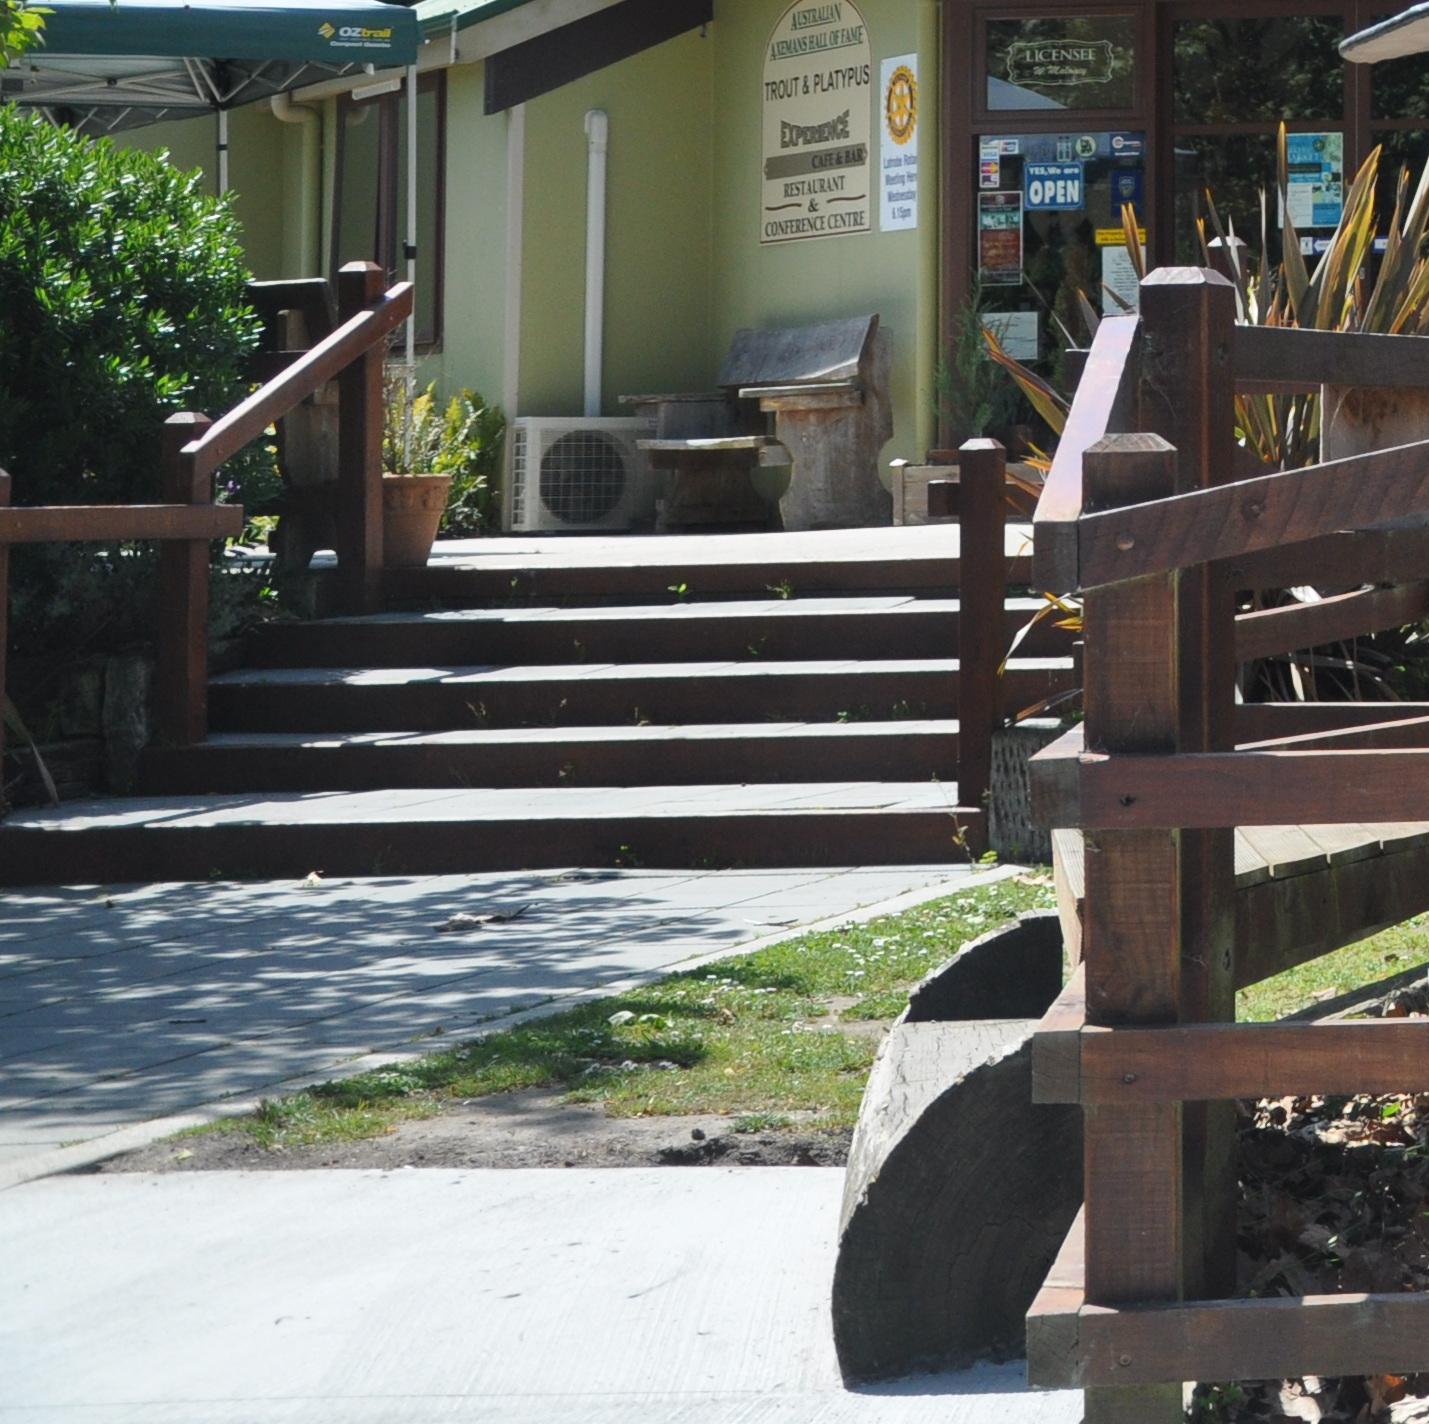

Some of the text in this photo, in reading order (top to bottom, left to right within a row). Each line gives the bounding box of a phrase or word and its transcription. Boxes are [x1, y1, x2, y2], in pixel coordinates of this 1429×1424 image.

[791, 2, 842, 31] AUSTRALIAN
[339, 26, 392, 38] OZtrail
[770, 25, 864, 61] AXEMANS HALL OF FAME
[1025, 48, 1097, 62] LICENSEE
[765, 64, 870, 101] TROUT & PLATYPUS
[780, 109, 850, 149] EXPERIENCE
[835, 151, 844, 166] &
[844, 147, 864, 164] BAR
[783, 175, 846, 198] RESTAURANT
[1029, 180, 1080, 205] OPEN
[808, 198, 819, 212] &
[765, 211, 865, 237] CONFERENCE CENTRE
